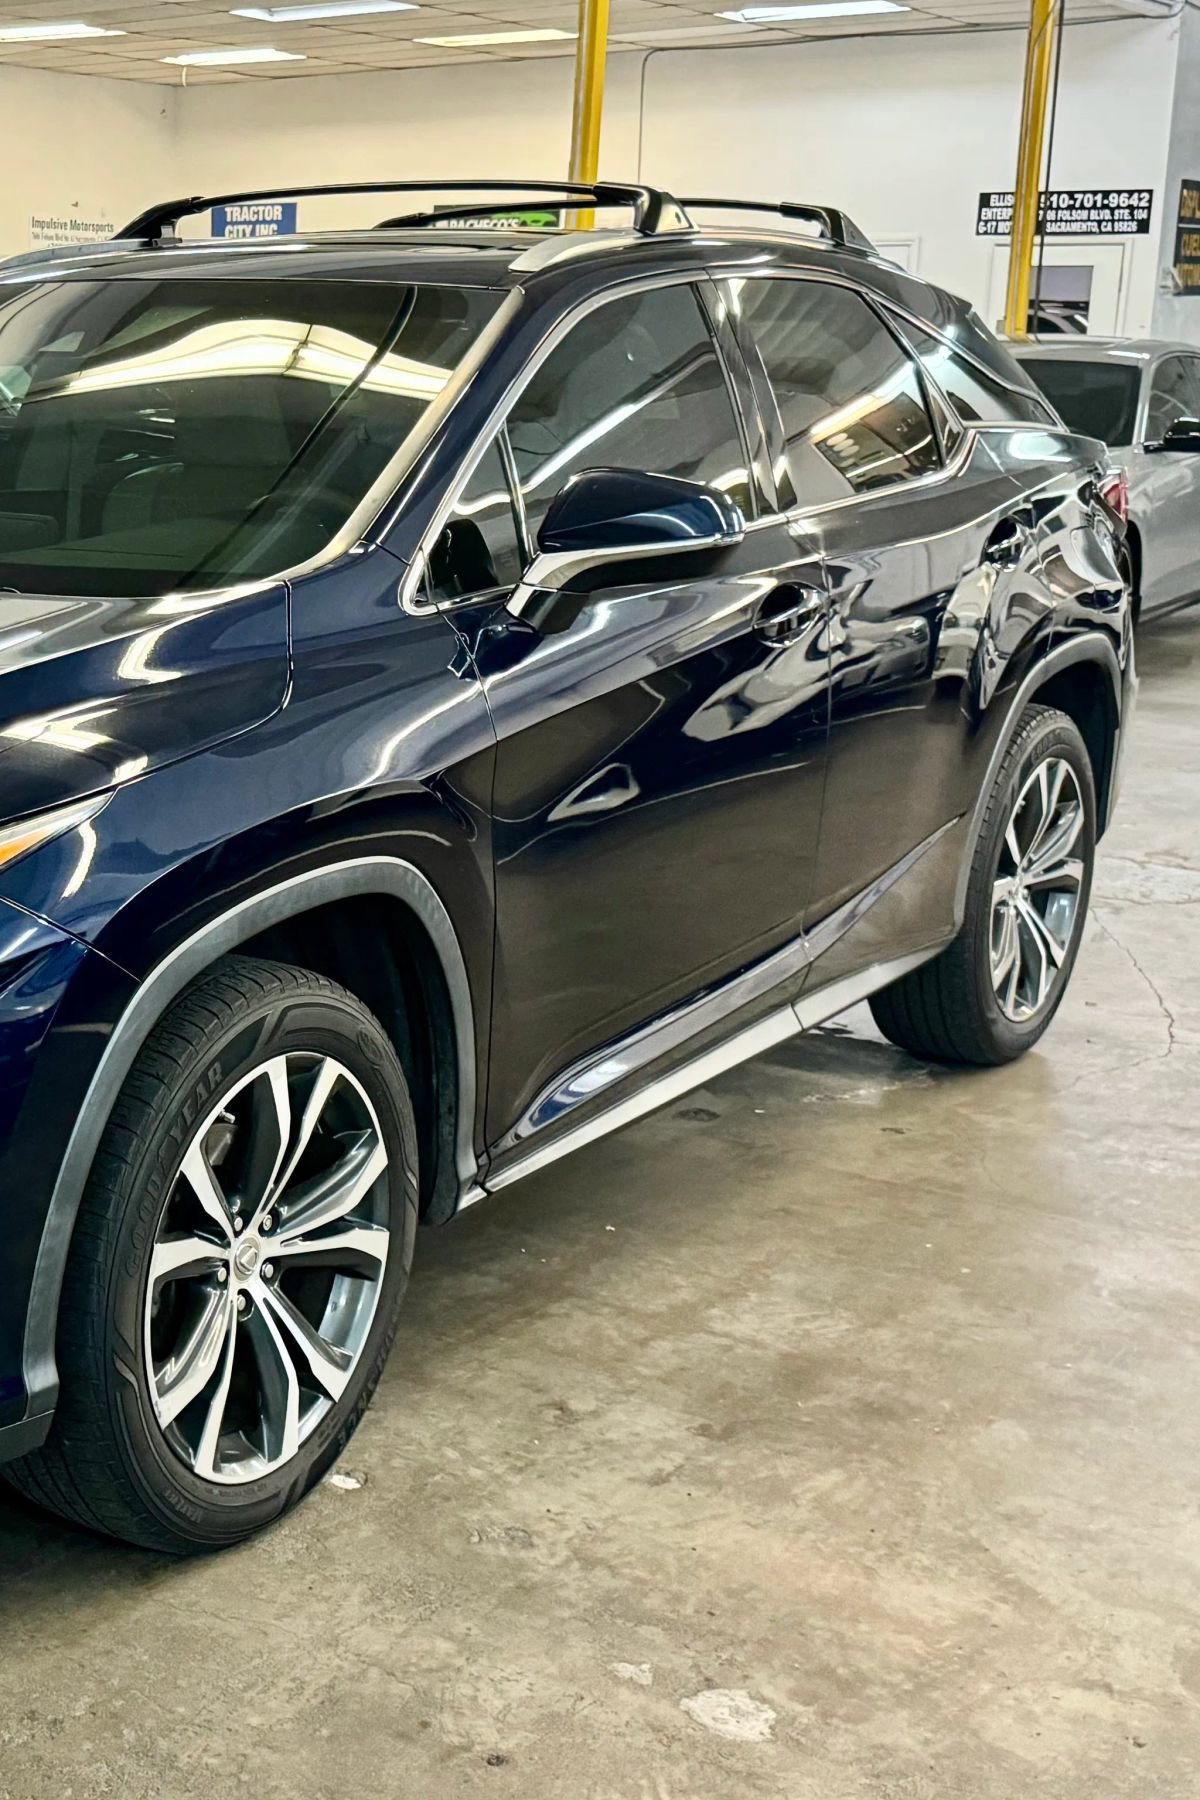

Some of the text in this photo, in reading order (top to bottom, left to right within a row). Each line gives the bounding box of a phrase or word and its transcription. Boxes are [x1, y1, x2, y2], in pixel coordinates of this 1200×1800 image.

[224, 205, 283, 223] TRACTOR
[980, 207, 1013, 220] ENTERP
[1038, 209, 1056, 221] 706
[1057, 209, 1089, 221] FOLSOM
[1133, 208, 1148, 219] 104
[31, 216, 115, 235] Impulsive Motorsports
[224, 224, 253, 238] CITY
[997, 221, 1012, 234] MO
[1100, 221, 1113, 232] CA
